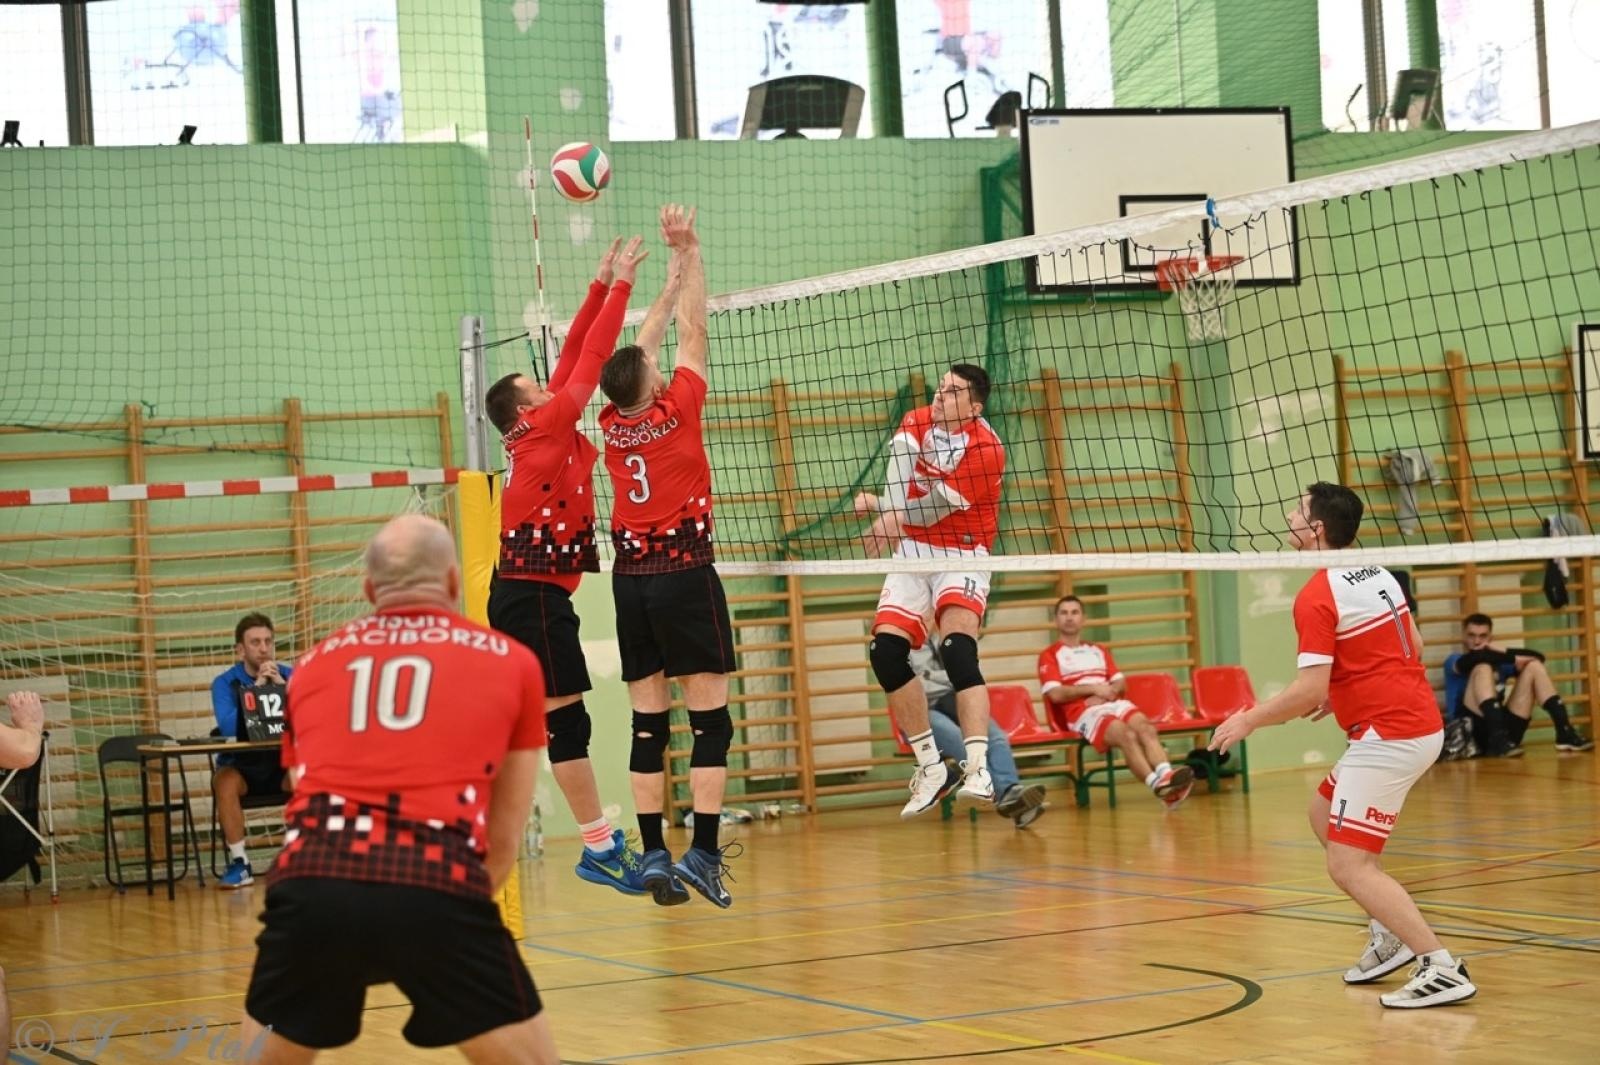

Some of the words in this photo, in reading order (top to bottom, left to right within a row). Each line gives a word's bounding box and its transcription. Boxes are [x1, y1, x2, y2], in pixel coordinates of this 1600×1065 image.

[624, 453, 651, 504] 3
[1377, 588, 1412, 659] 1
[259, 692, 285, 718] 12
[345, 654, 433, 733] 10
[1334, 798, 1347, 832] 1
[1365, 806, 1399, 826] Pers
